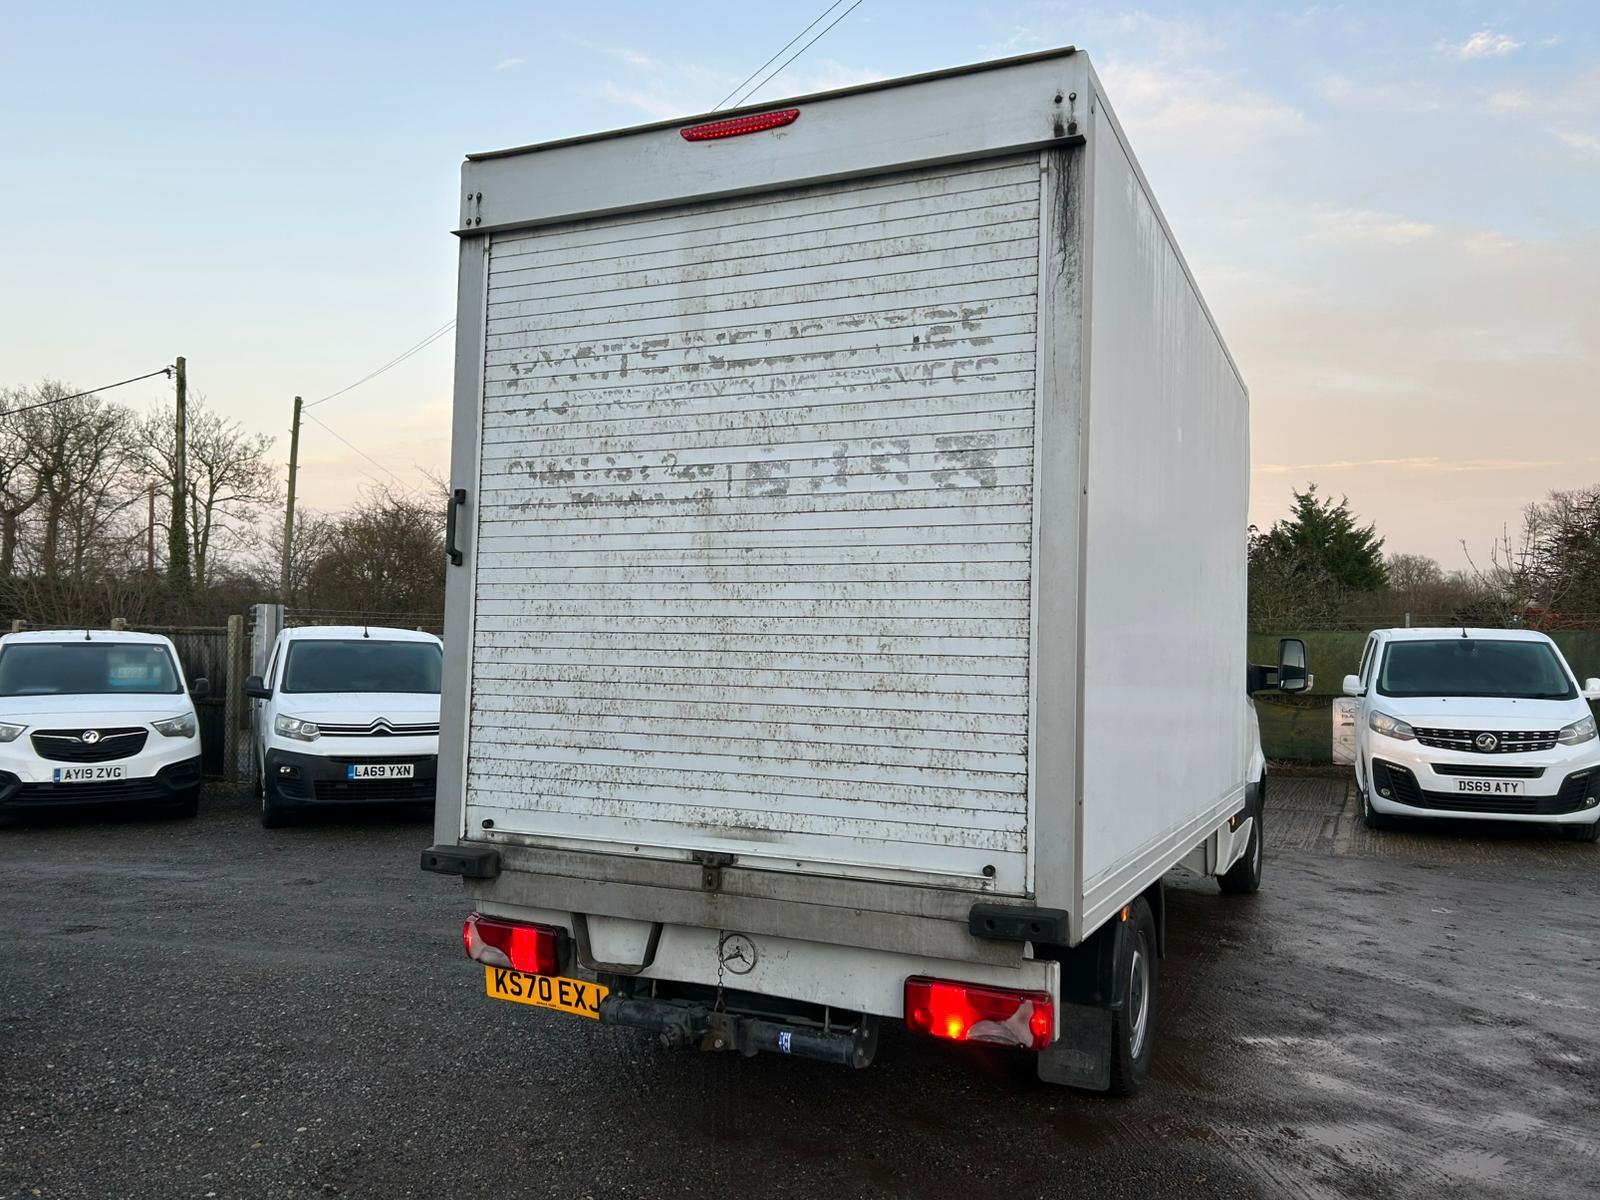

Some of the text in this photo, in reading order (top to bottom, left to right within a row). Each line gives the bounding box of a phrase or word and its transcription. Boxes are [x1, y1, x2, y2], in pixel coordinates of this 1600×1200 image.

[64, 767, 122, 780] AY19 ZVG
[355, 765, 411, 777] LA69 YXN
[1458, 780, 1519, 793] DS69 ATY
[494, 967, 600, 1013] KS70 EXJ
